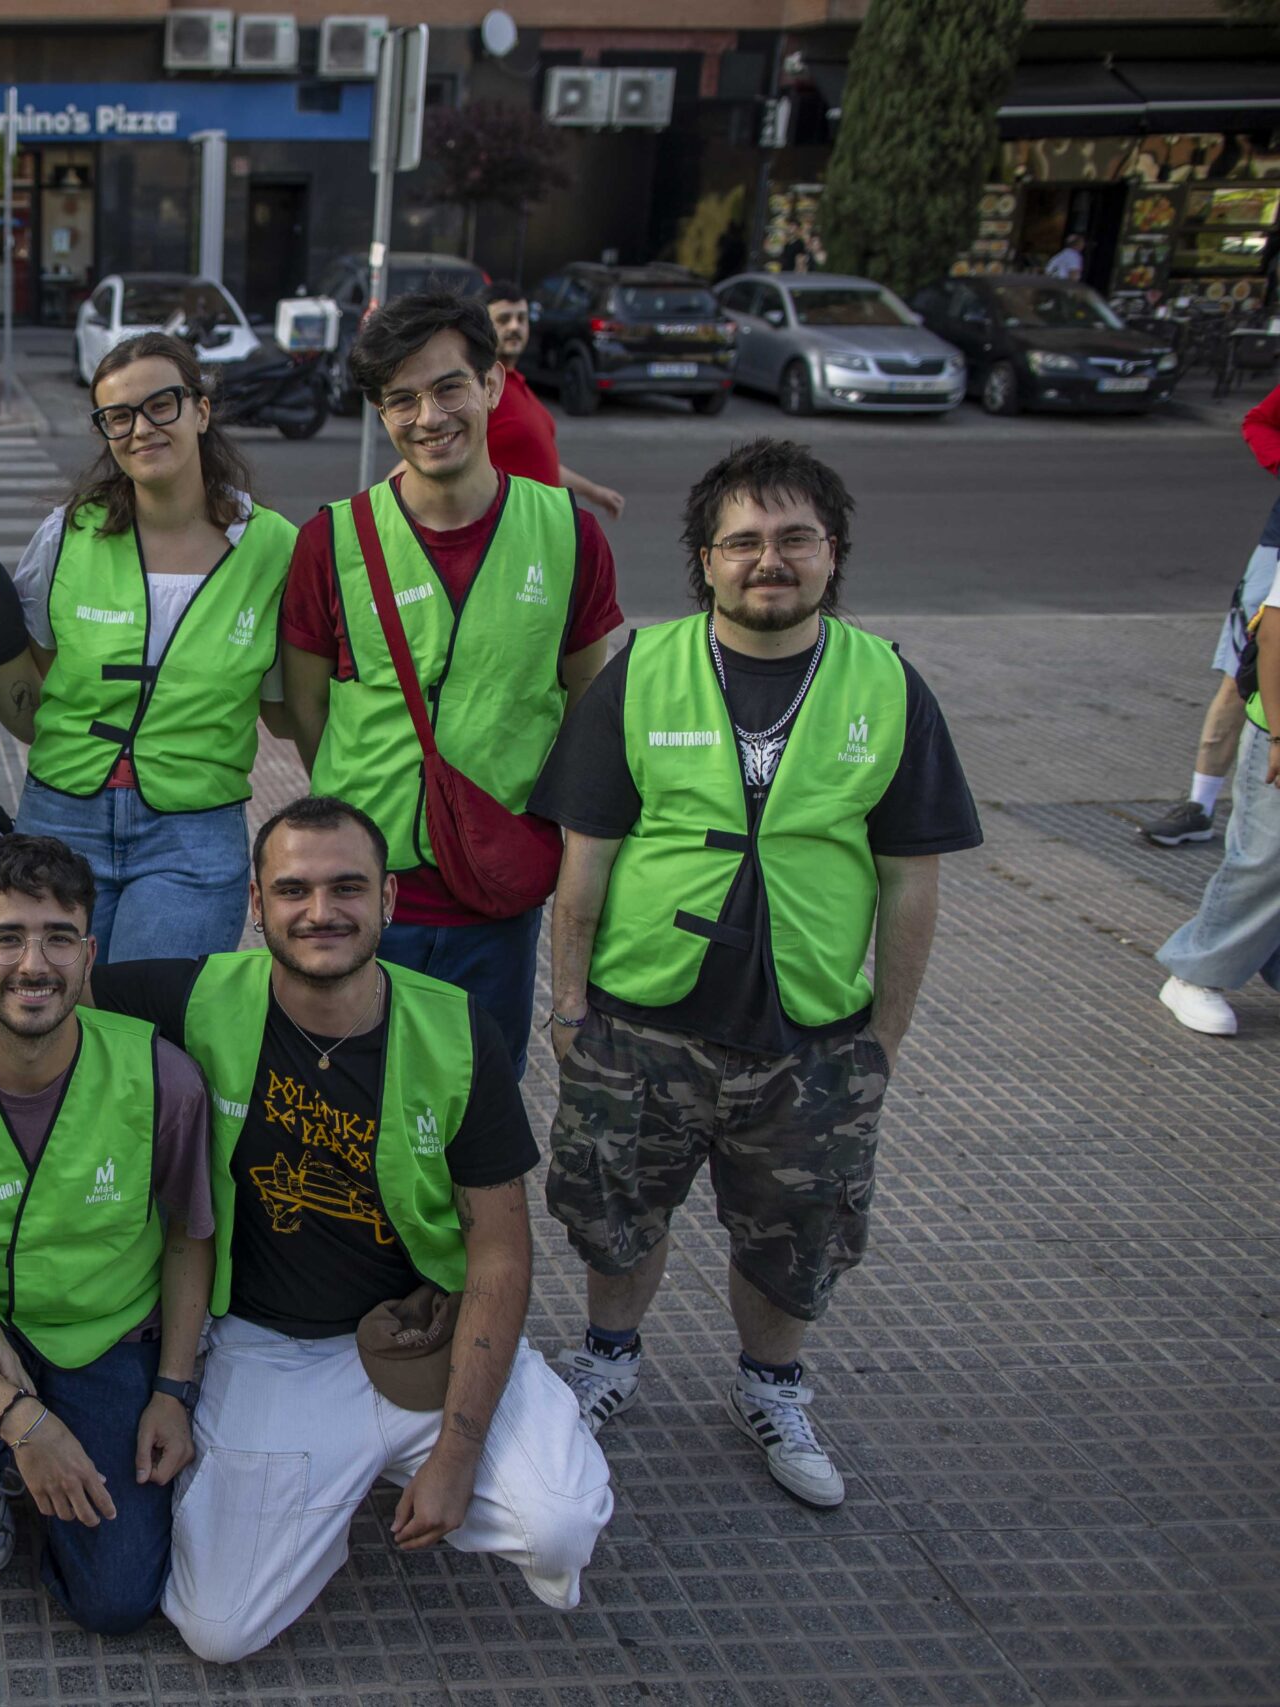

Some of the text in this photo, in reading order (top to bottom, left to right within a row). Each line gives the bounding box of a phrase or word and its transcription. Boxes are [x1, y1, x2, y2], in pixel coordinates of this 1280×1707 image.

[96, 103, 178, 134] Pizza
[838, 752, 876, 763] Madrid
[412, 1143, 444, 1154] Madri
[94, 1184, 114, 1194] Más
[86, 1191, 121, 1204] Madrid
